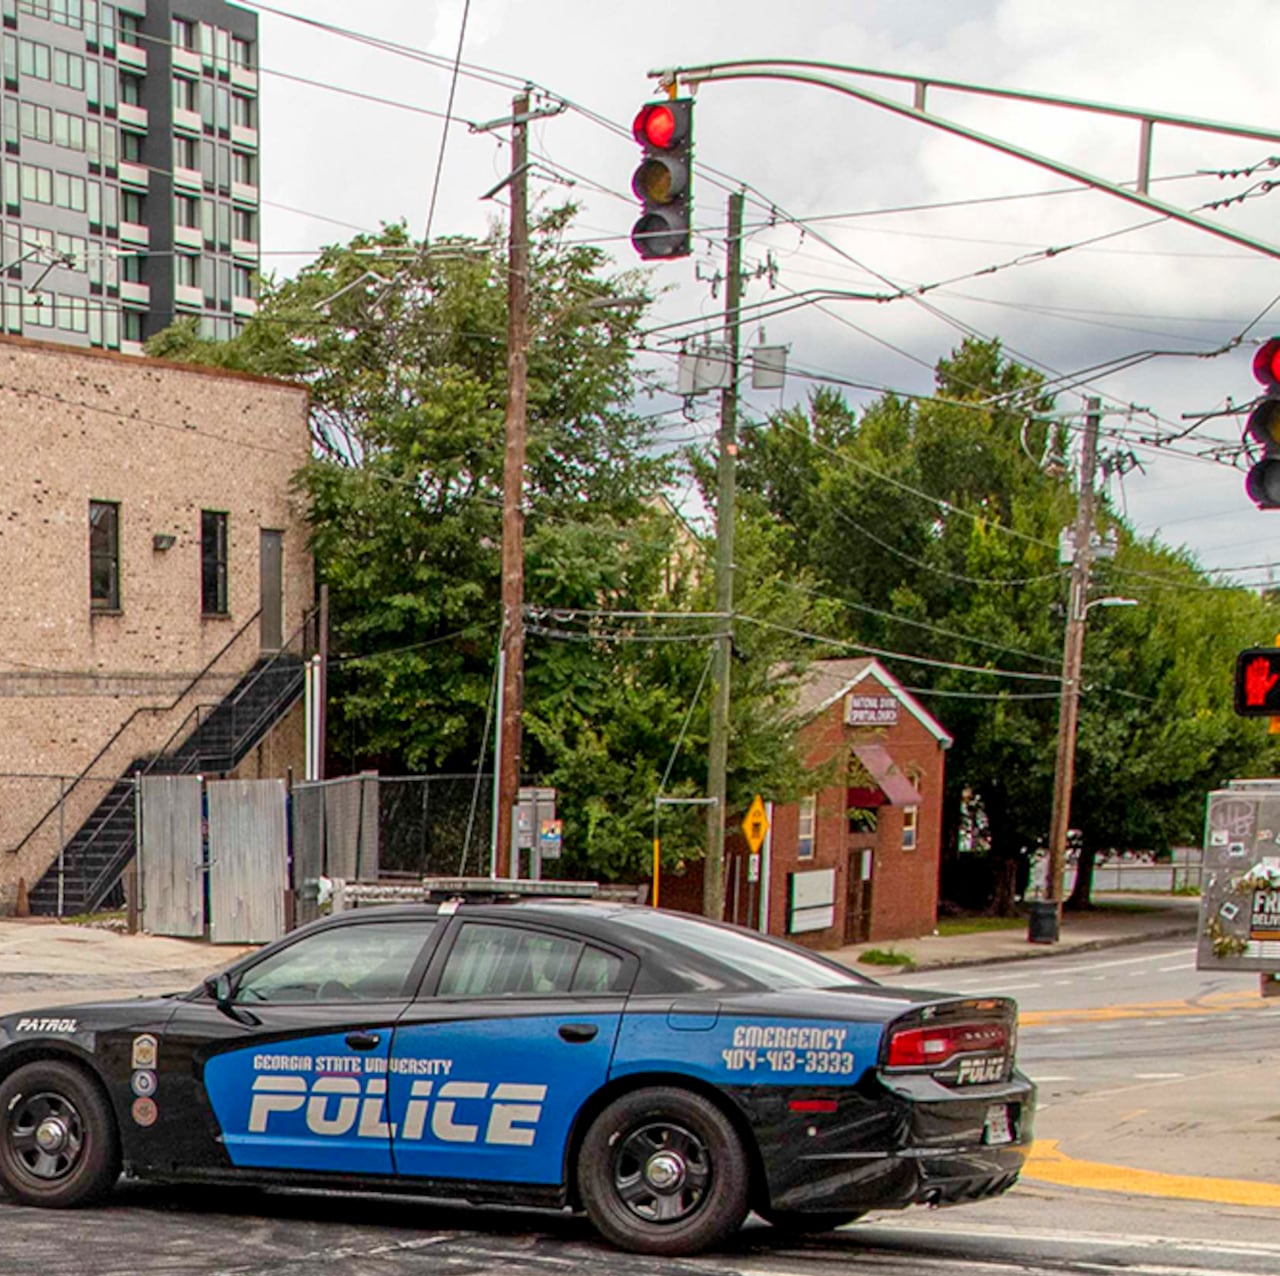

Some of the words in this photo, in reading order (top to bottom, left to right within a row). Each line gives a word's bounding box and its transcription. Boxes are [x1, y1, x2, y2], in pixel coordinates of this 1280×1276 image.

[1254, 889, 1280, 914] FR
[16, 1018, 78, 1033] PATROL
[733, 1026, 847, 1050] EMERGENCY
[253, 1055, 312, 1071] GEORGIA
[315, 1057, 362, 1072] STATE
[365, 1058, 453, 1075] UNIVERSITY
[721, 1050, 855, 1074] 404-413-3333
[956, 1057, 1006, 1085] POLICE
[248, 1075, 548, 1146] POLICE
